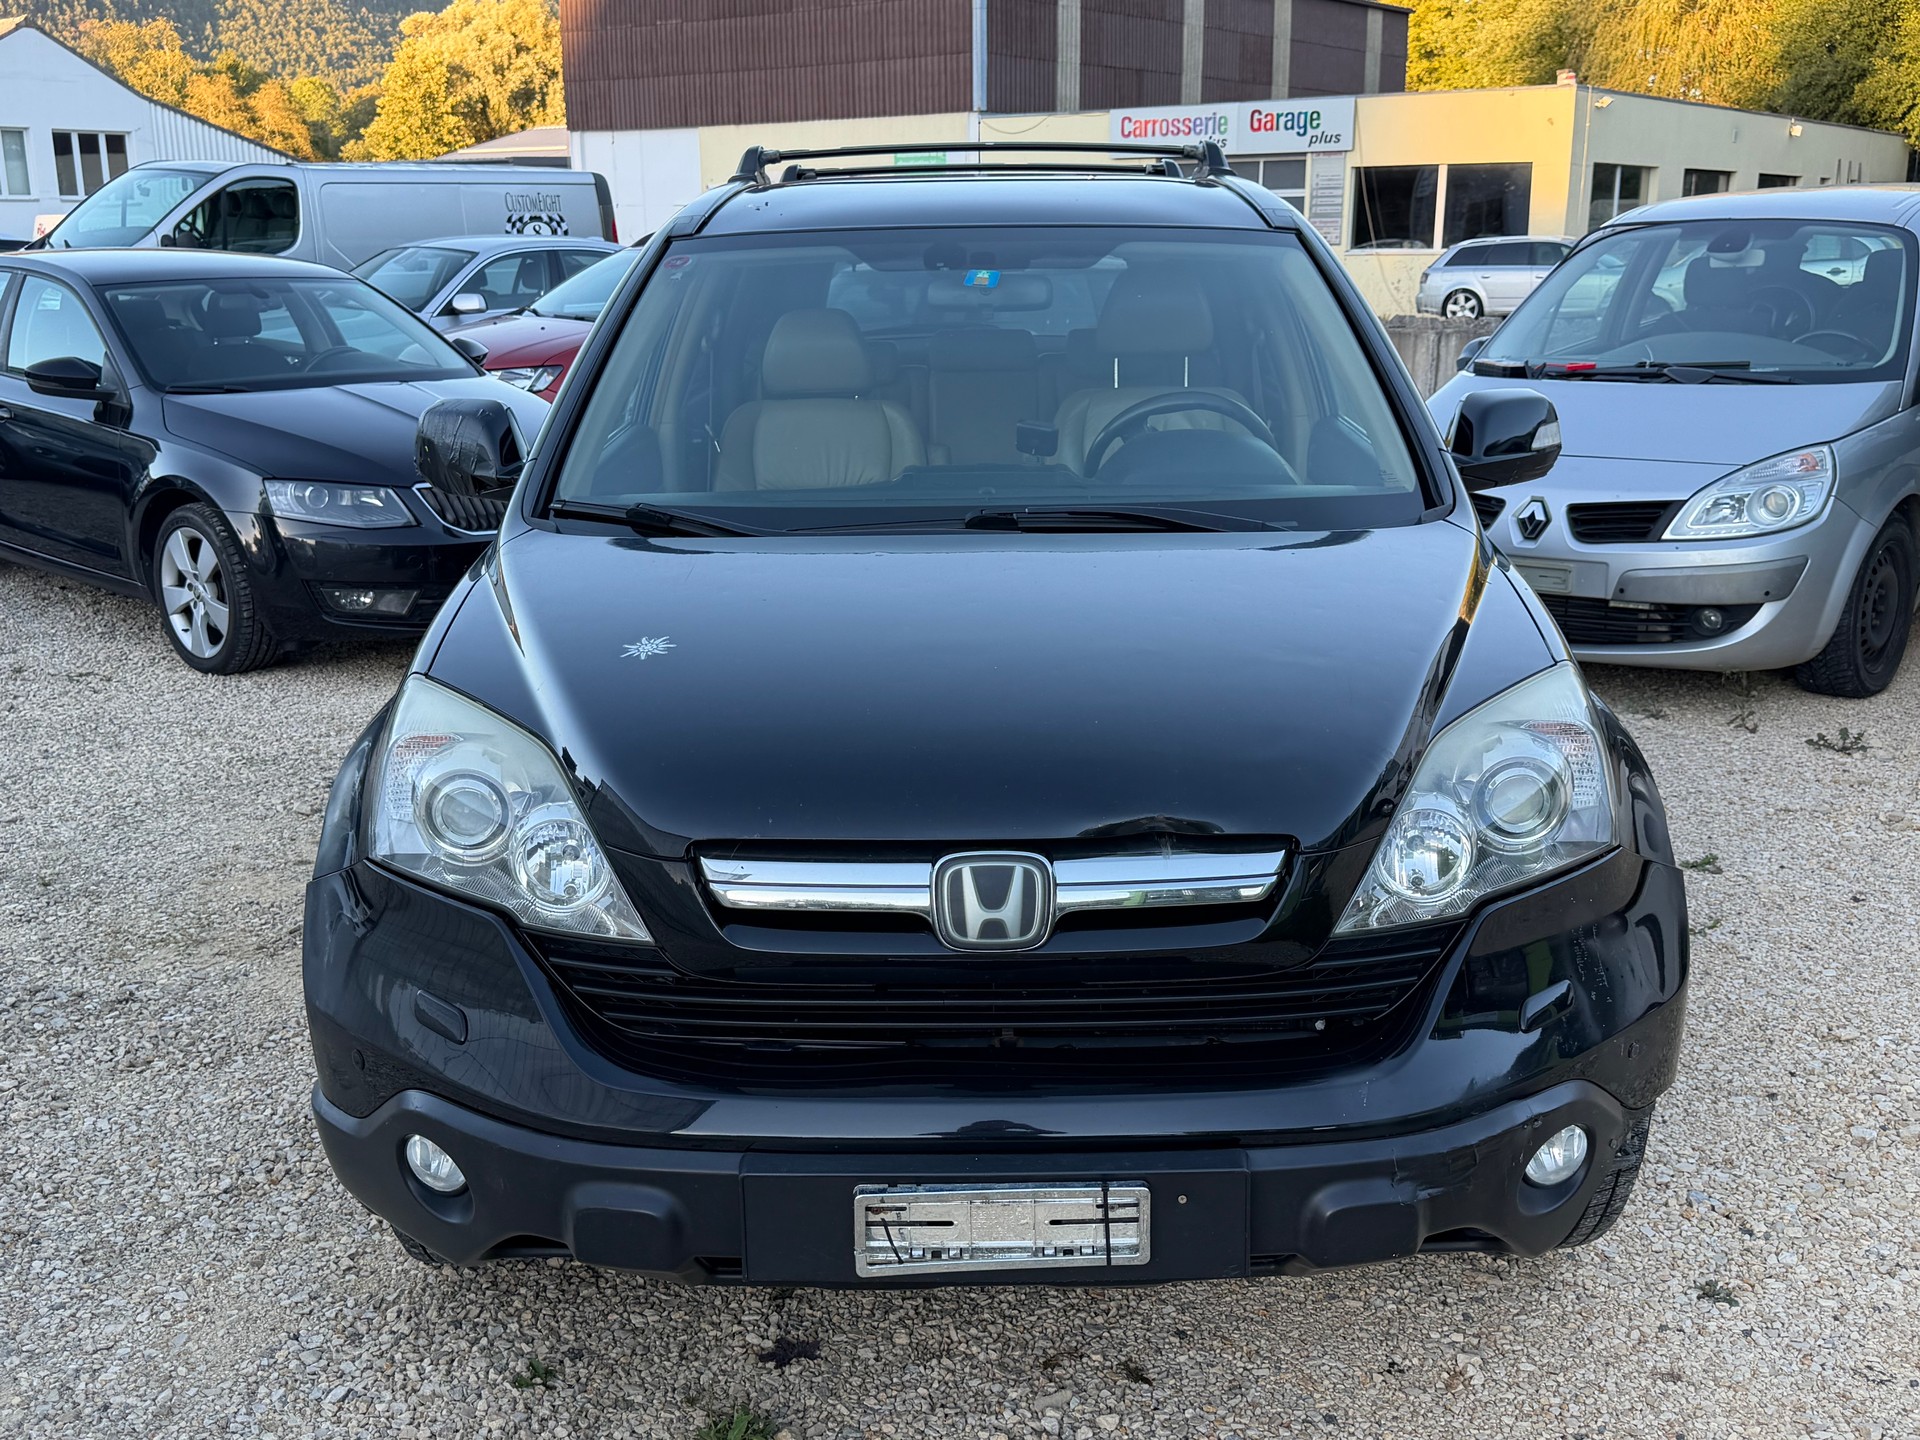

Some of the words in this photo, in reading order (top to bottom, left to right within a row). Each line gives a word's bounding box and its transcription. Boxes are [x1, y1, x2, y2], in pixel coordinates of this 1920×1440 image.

[1120, 112, 1228, 139] Carrosserie
[1250, 109, 1321, 137] Garage
[1308, 130, 1342, 148] plus
